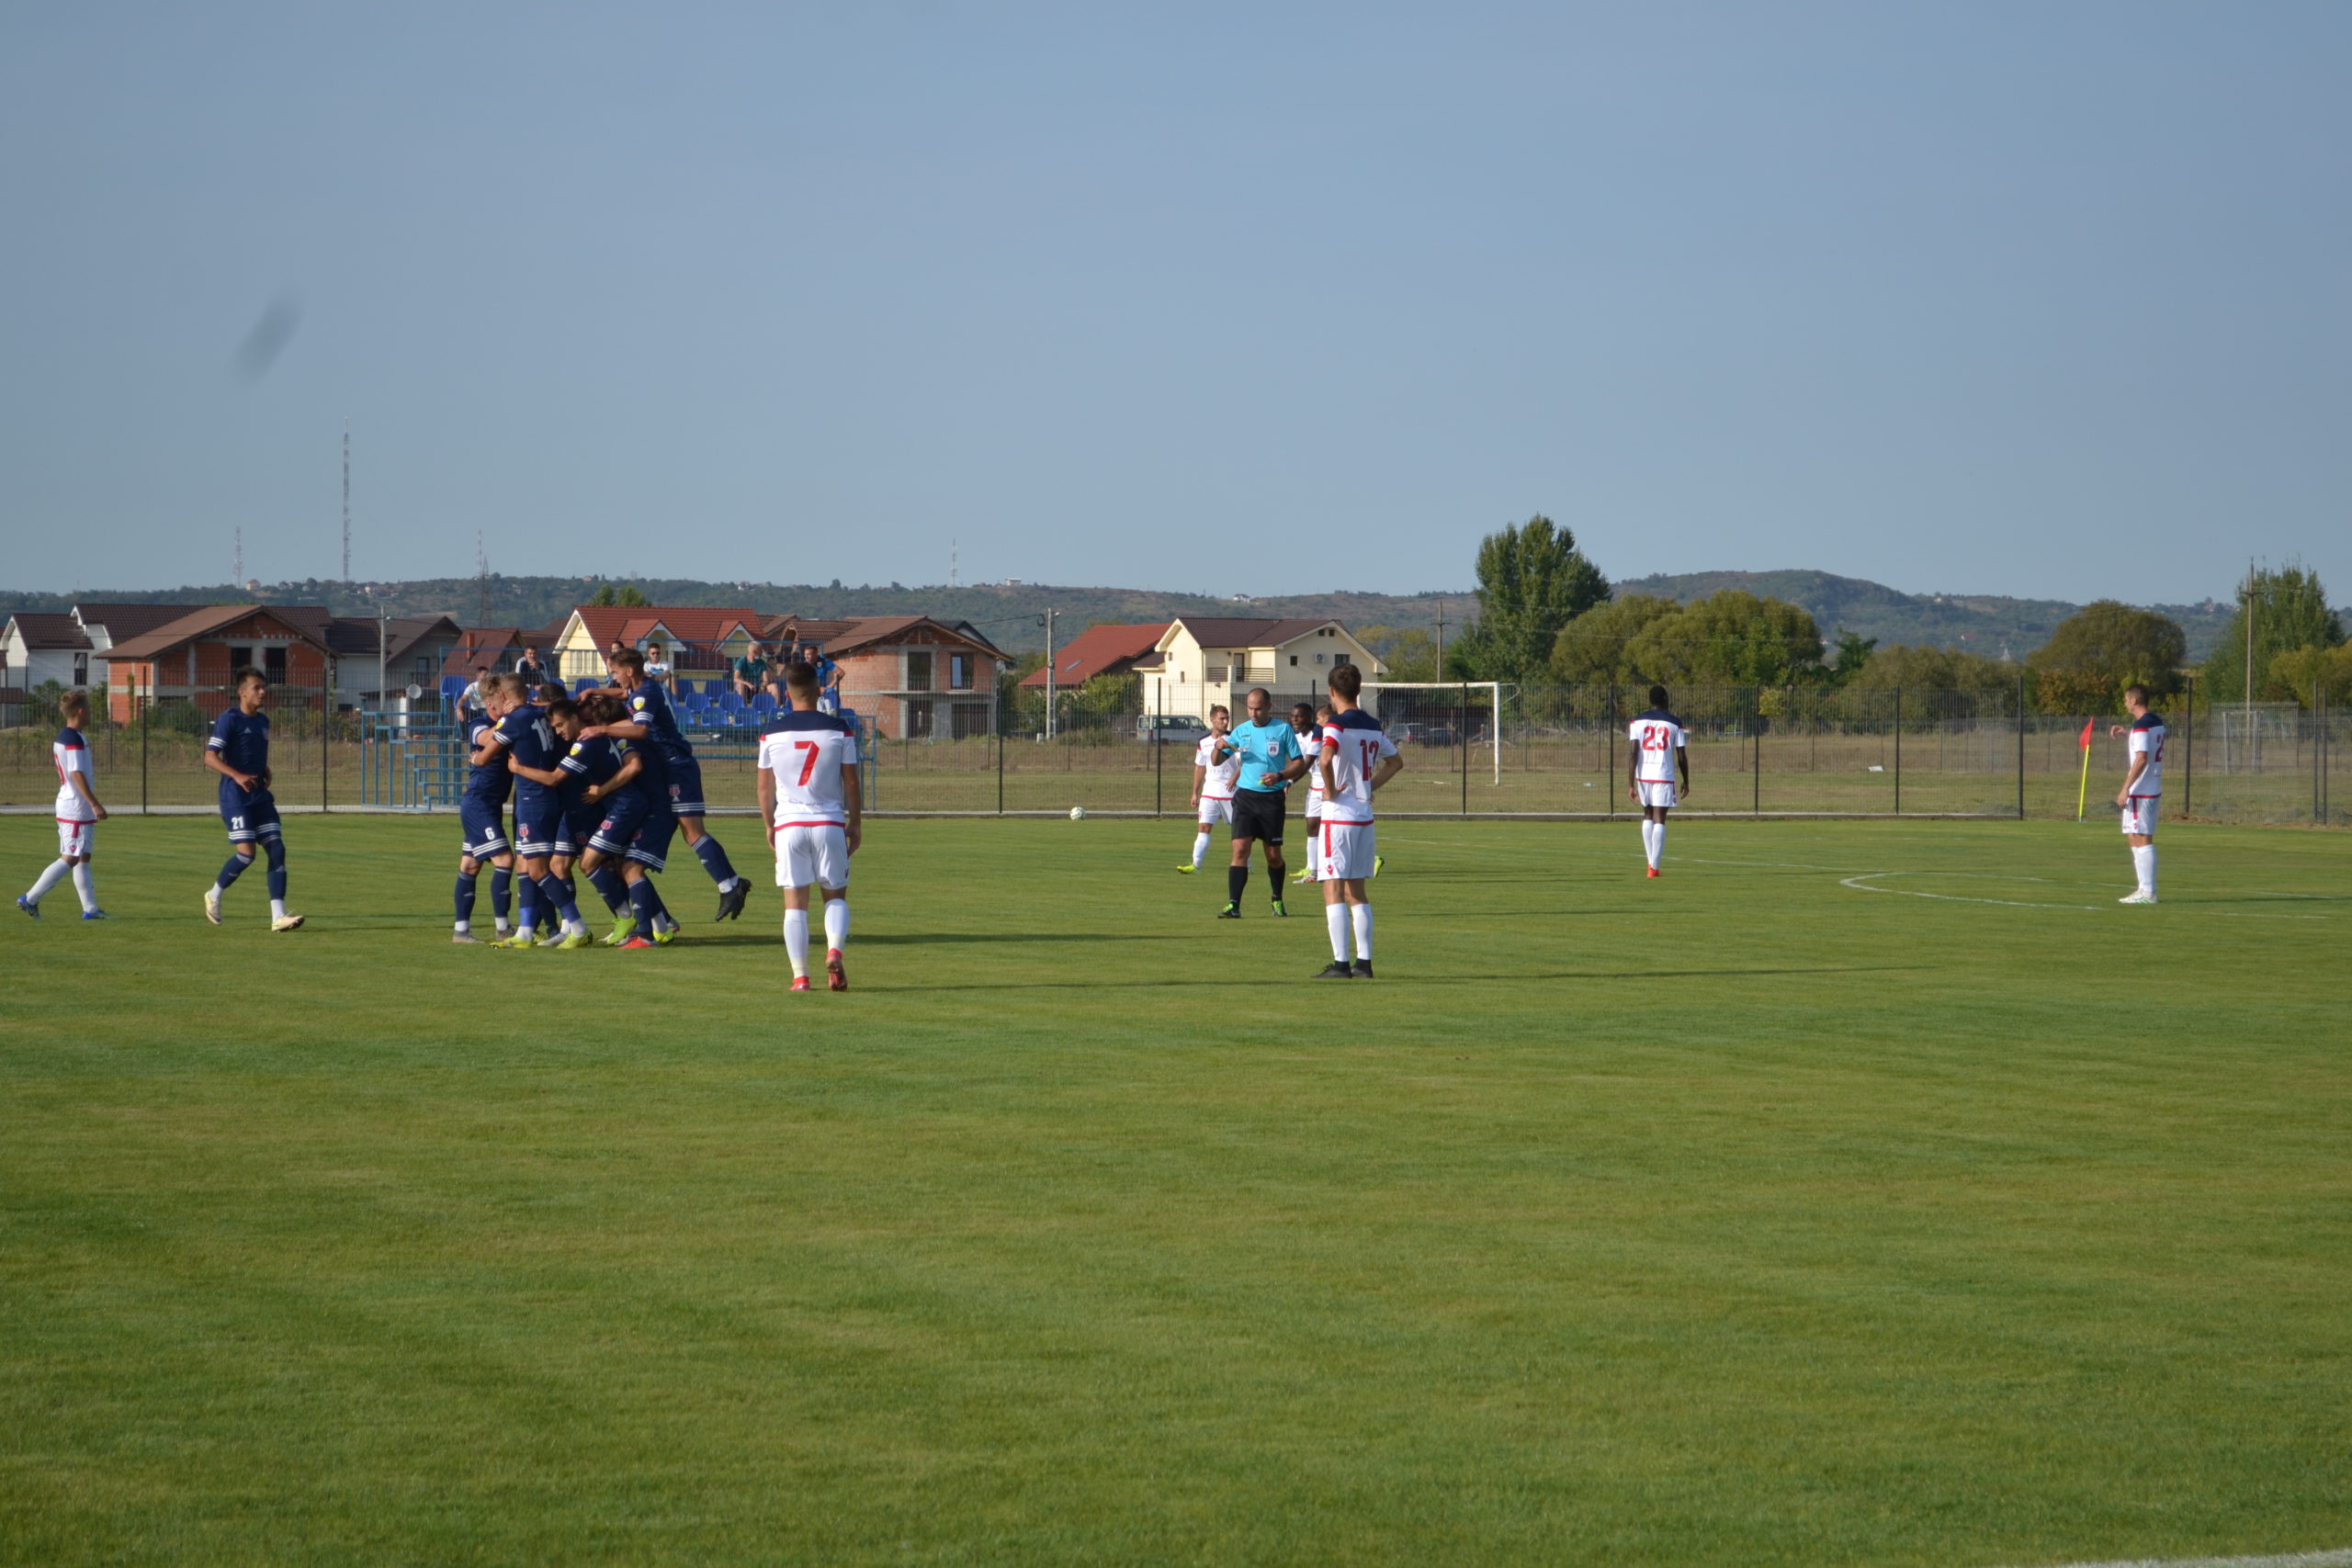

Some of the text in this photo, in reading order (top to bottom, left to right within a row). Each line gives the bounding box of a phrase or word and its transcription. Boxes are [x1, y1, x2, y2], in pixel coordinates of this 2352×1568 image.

[1643, 726, 1669, 751] 23
[795, 740, 820, 787] 7
[232, 816, 244, 830] 21
[485, 827, 495, 840] 6
